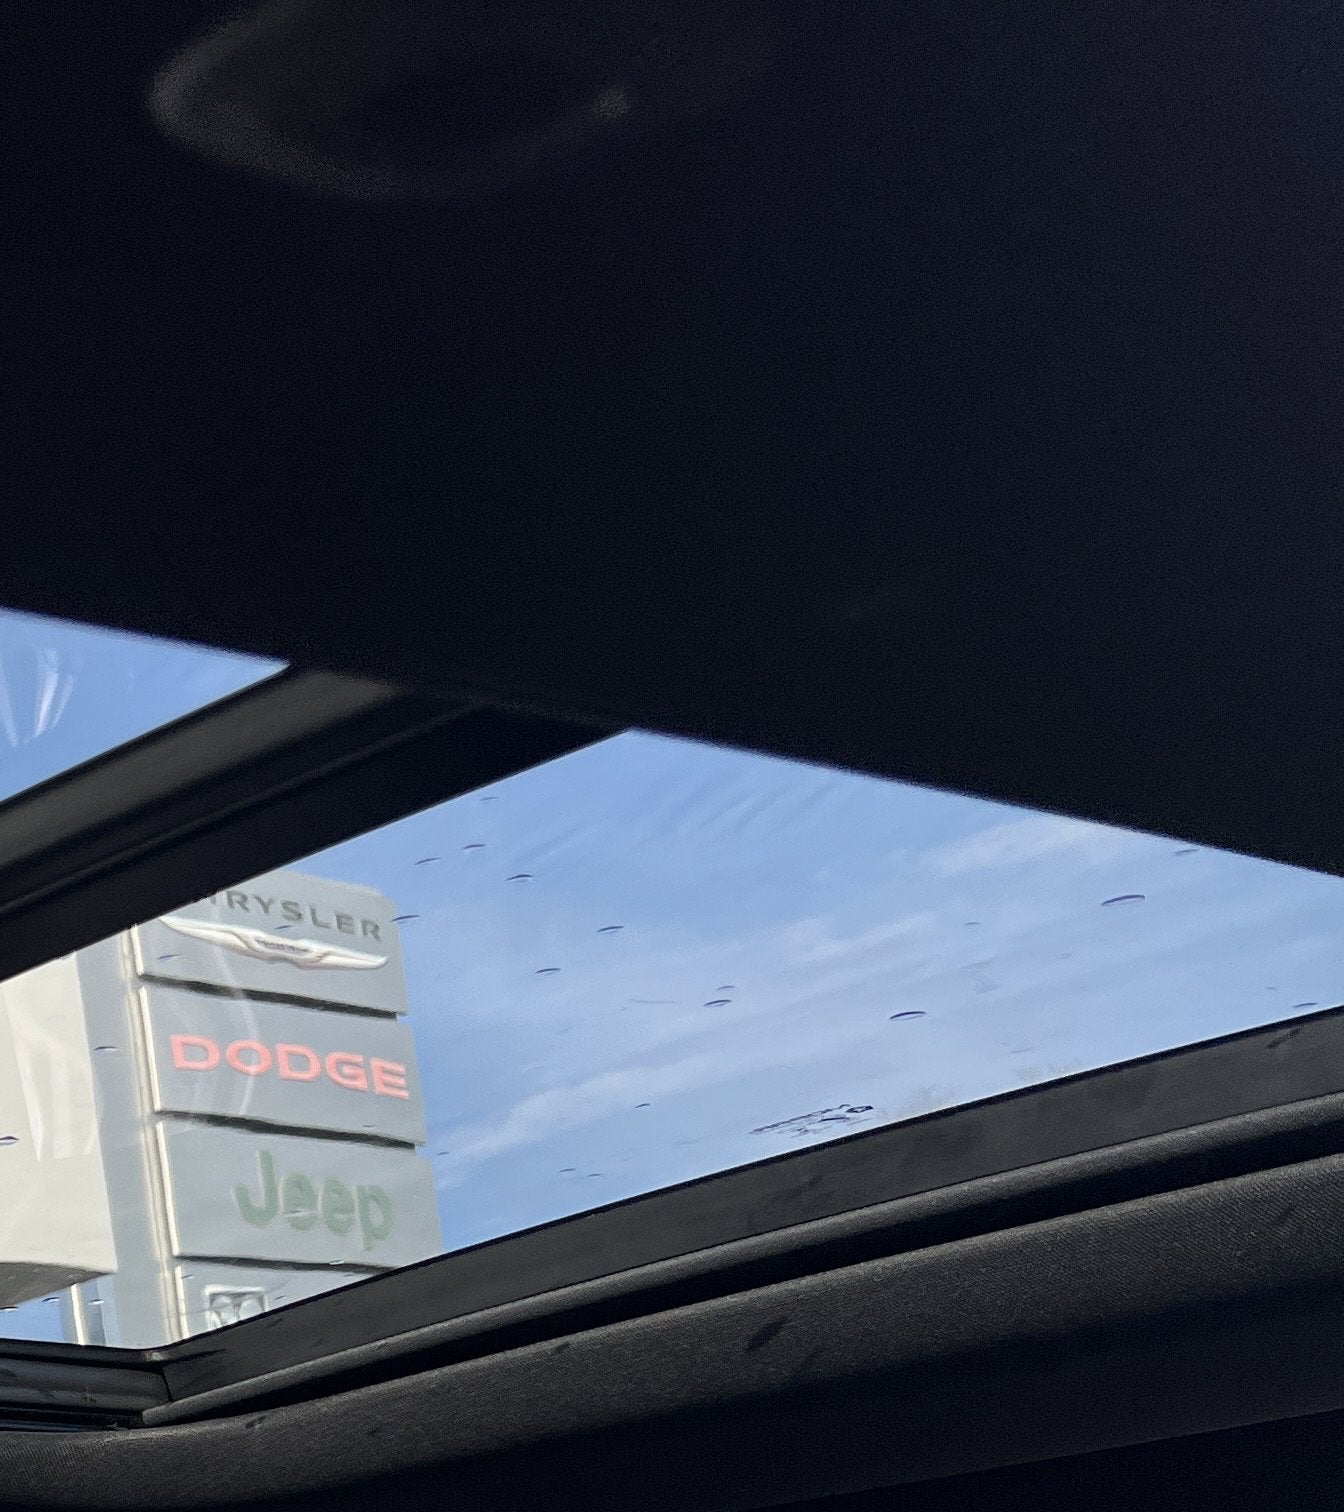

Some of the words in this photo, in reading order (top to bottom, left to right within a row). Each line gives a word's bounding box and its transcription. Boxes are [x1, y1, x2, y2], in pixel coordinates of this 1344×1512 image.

[209, 889, 383, 944] RYSLER
[171, 1035, 409, 1099] DODGE
[234, 1150, 395, 1250] Jeep
